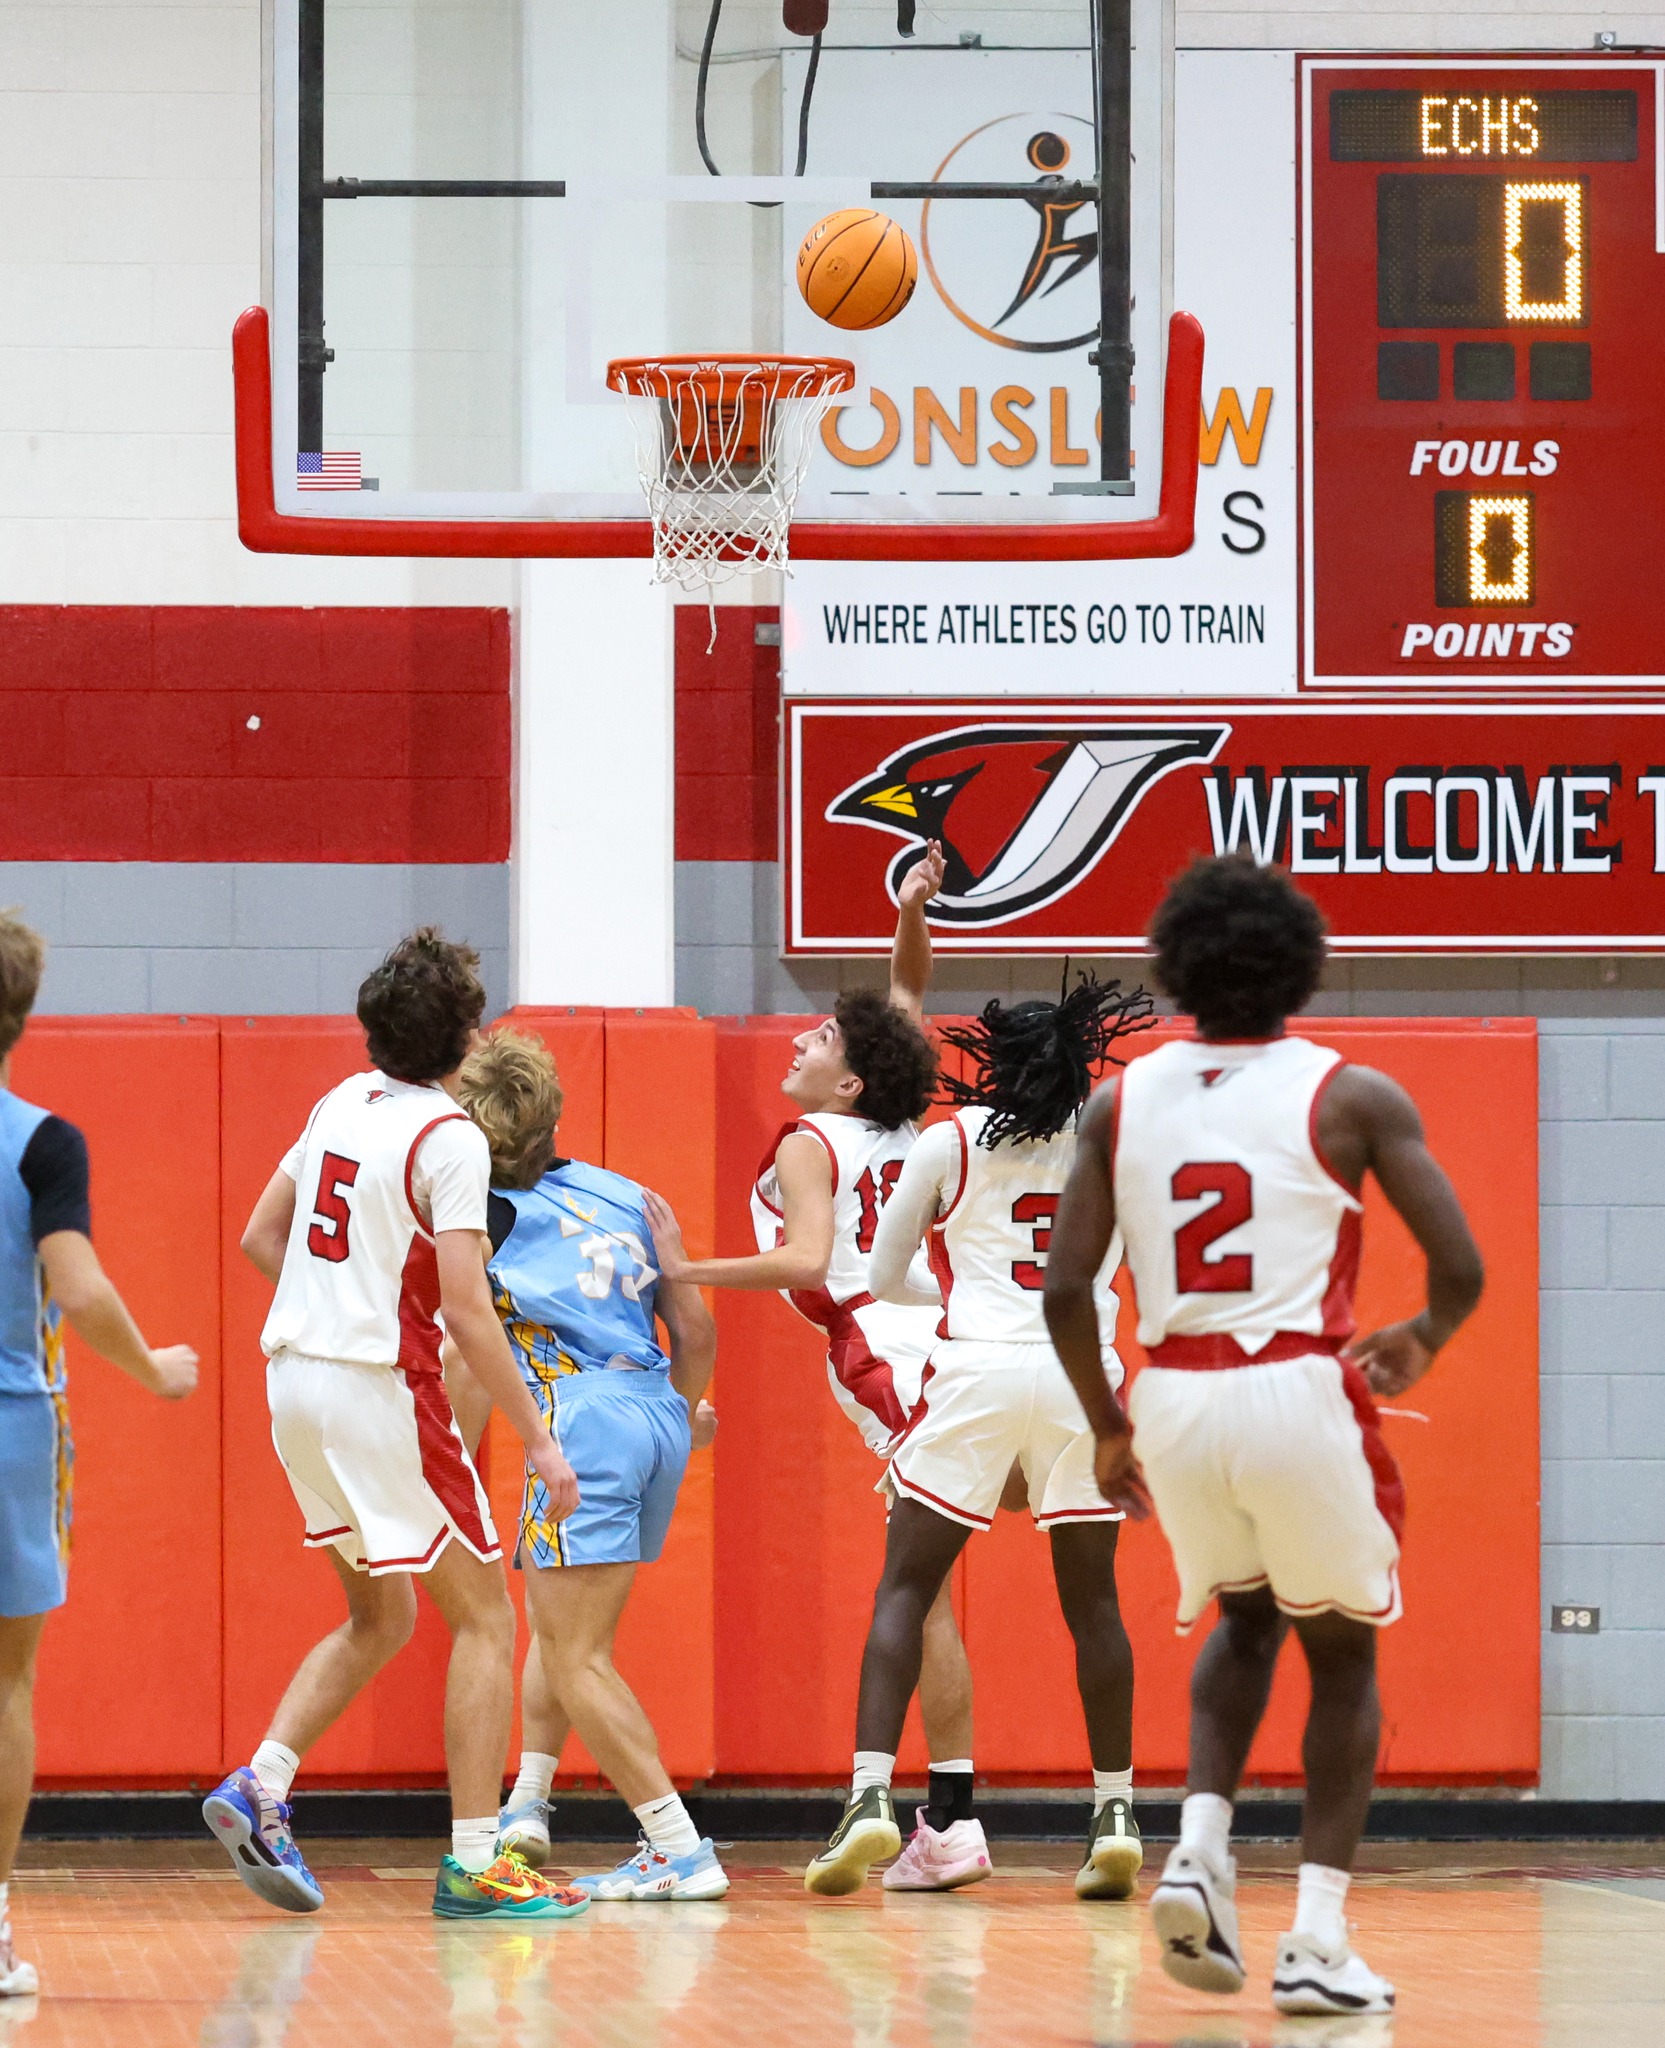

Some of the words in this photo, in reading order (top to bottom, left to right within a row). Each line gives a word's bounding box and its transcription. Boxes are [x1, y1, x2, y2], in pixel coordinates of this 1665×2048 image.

[1421, 96, 1540, 155] ECHS
[1504, 182, 1582, 320] 0
[820, 386, 1274, 467] ONSLW
[1408, 439, 1561, 478] FOULS
[1468, 497, 1529, 600] 0
[823, 603, 928, 644] WHERE
[937, 603, 1077, 645] ATHLETES
[1086, 603, 1127, 645] GO
[1136, 603, 1171, 645] TO
[1180, 603, 1265, 644] TRAIN
[1400, 622, 1575, 659] POINTS
[1202, 770, 1616, 874] WELCOME
[307, 1149, 361, 1264] 5
[1011, 1192, 1063, 1291] 3
[1171, 1161, 1253, 1295] 2
